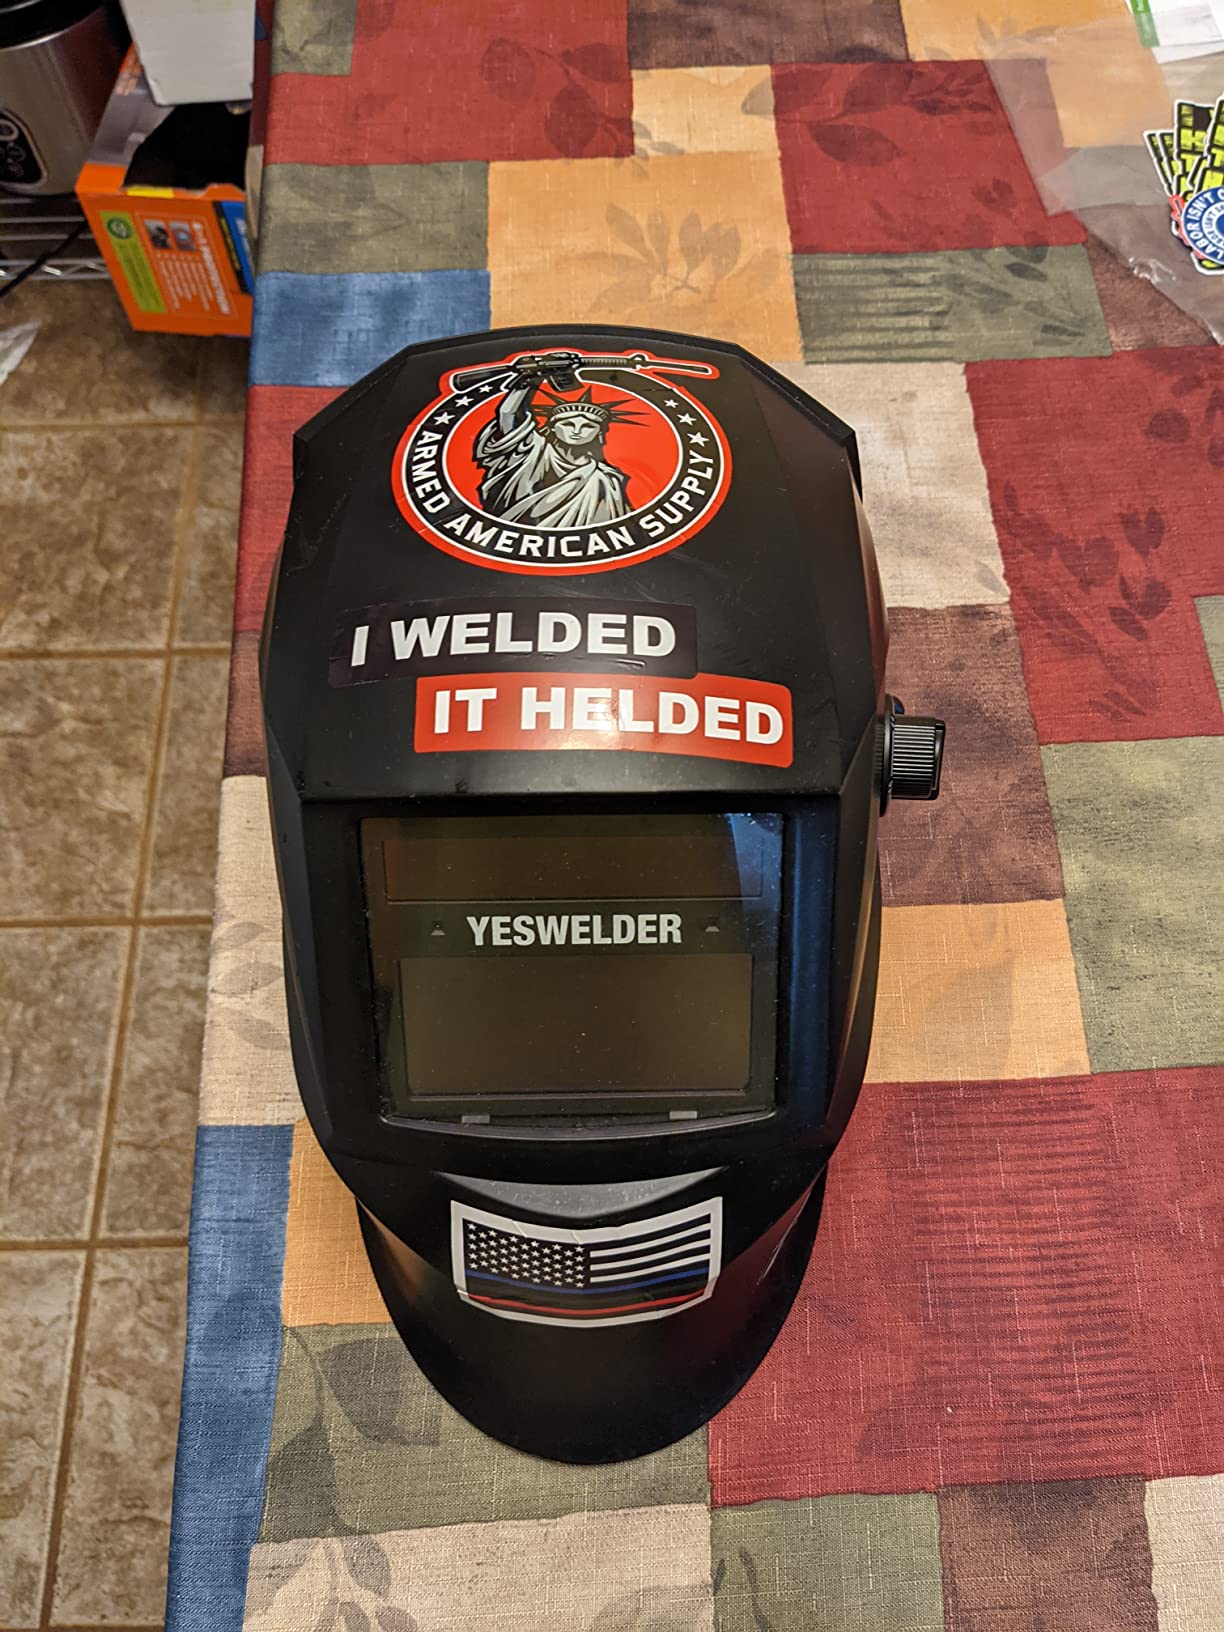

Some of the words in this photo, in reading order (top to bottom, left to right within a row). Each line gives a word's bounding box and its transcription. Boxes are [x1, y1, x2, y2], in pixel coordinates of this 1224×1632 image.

[1187, 191, 1214, 220] ISN'T
[1187, 222, 1224, 260] LABOR
[411, 430, 450, 514] ARMED
[445, 513, 635, 558] AMERICAN
[639, 451, 714, 538] SUPPLY
[351, 625, 370, 667] I
[390, 611, 677, 661] WELDED
[434, 687, 498, 734] IT
[521, 687, 784, 745] HELDED
[466, 913, 682, 946] YESWELDER
